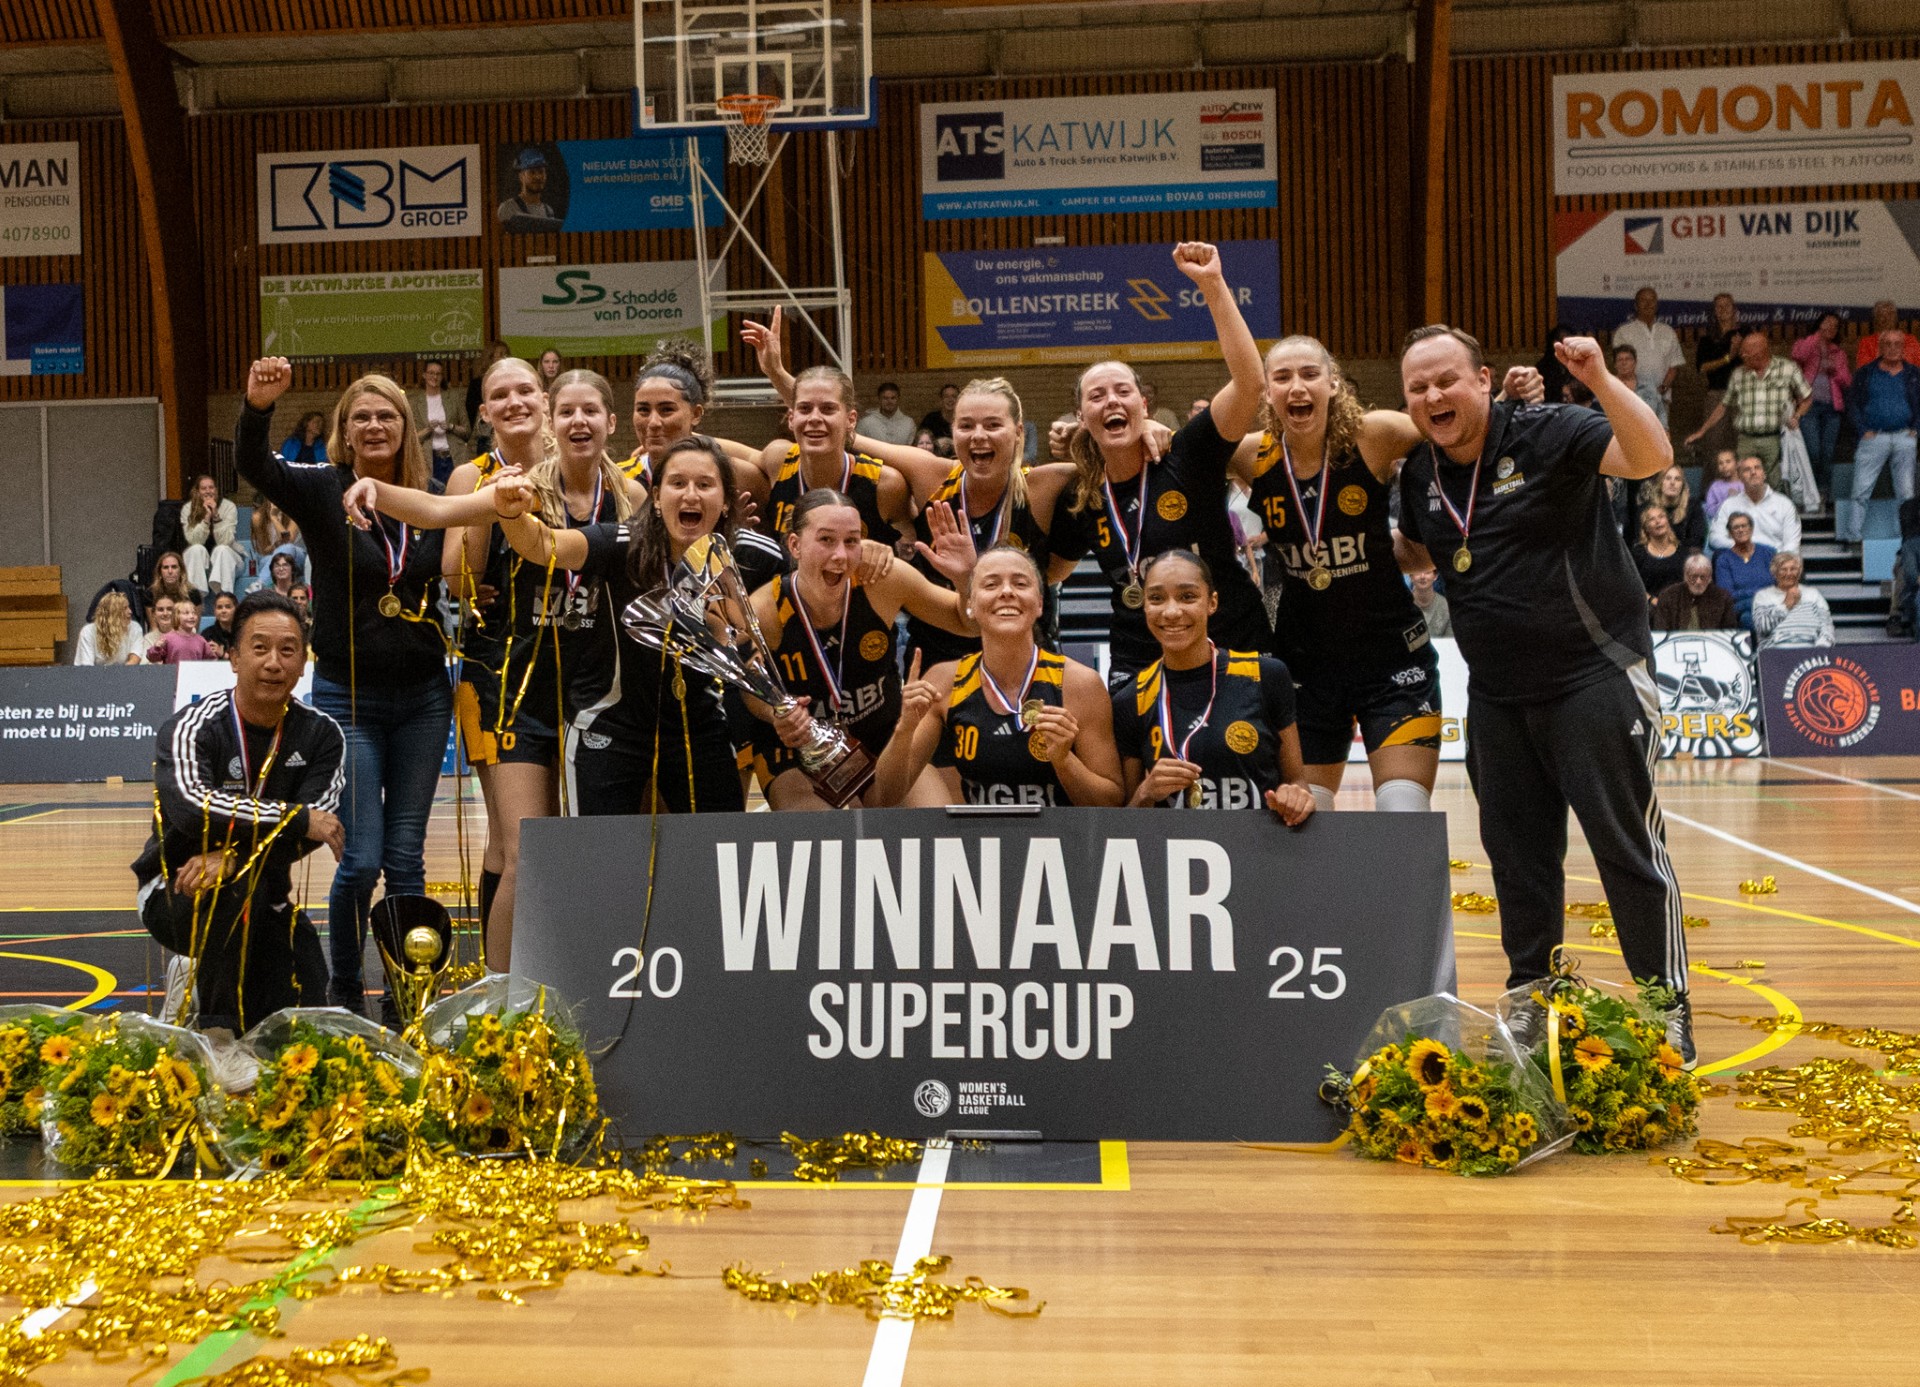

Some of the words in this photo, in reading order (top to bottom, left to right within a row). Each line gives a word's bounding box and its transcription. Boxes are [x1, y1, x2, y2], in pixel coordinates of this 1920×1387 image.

[1567, 79, 1914, 139] ROMONTA
[937, 125, 1005, 156] ATS
[1012, 119, 1176, 153] KATWIJK
[1222, 130, 1261, 140] BOSCH
[582, 160, 626, 171] NIEUWE
[629, 159, 659, 169] BAAN
[1014, 158, 1036, 168] Auto
[1038, 157, 1046, 166] &
[1049, 156, 1077, 166] Truck
[1080, 155, 1117, 165] Service
[1119, 153, 1157, 164] Katwijk
[1160, 152, 1180, 161] B.V.
[1567, 166, 1607, 177] FOOD
[1611, 161, 1695, 176] CONVEYORS
[1700, 161, 1709, 172] &
[1714, 158, 1785, 171] STAINLESS
[1789, 157, 1825, 169] STEEL
[1832, 153, 1914, 167] PLATFORMS
[0, 158, 68, 188] MAN
[5, 195, 70, 207] PENSIOENEN
[270, 157, 468, 232] KBM
[650, 195, 684, 207] GMB
[936, 198, 1040, 211] WWW.ATSKATWIJK.NL
[1061, 196, 1099, 206] CAMPER
[1103, 196, 1116, 204] EN
[1119, 194, 1162, 203] CARAVAN
[1166, 191, 1205, 202] BOVAG
[1207, 190, 1266, 200] ONDERHOUD
[401, 211, 468, 227] GROEP
[1671, 214, 1725, 239] GBI
[1738, 212, 1792, 236] VAN
[1805, 210, 1860, 238] DIJK
[2, 225, 70, 241] 4078900
[975, 259, 993, 271] Uw
[996, 258, 1045, 272] energie,
[263, 280, 285, 293] DE
[290, 277, 386, 292] KATWIJKSE
[391, 273, 481, 289] APOTHEEK
[995, 274, 1018, 285] ons
[1022, 270, 1104, 284] vakmanschap
[613, 289, 678, 305] Schaddé
[953, 292, 1120, 317] BOLLENSTREEK
[1179, 287, 1252, 307] SOR
[594, 309, 621, 322] van
[626, 305, 683, 320] Dooren
[1774, 308, 1785, 320] &
[1262, 496, 1286, 529] 15
[1097, 516, 1111, 548] 5
[780, 651, 808, 681] 11
[1782, 655, 1831, 699] BASKETBALL
[1835, 656, 1880, 702] NEDERLAND
[35, 707, 54, 719] ze
[58, 704, 78, 721] bij
[82, 706, 93, 718] u
[96, 702, 135, 721] zijn?
[3, 725, 47, 739] moet
[50, 727, 62, 739] u
[65, 723, 85, 741] bij
[89, 726, 120, 737] ons
[123, 722, 158, 740] zijn.
[1785, 703, 1835, 747] BASKETBALL
[1839, 704, 1881, 747] NEDERLAND
[954, 725, 979, 761] 30
[1150, 726, 1163, 761] 9
[715, 838, 1236, 972] WINNAAR
[609, 945, 684, 999] 20
[1267, 945, 1348, 999] 25
[807, 981, 1135, 1060] SUPERCUP
[958, 1082, 1007, 1094] WOMEN'S
[958, 1094, 1027, 1106] BASKETBALL
[958, 1106, 989, 1115] LEAGUE
